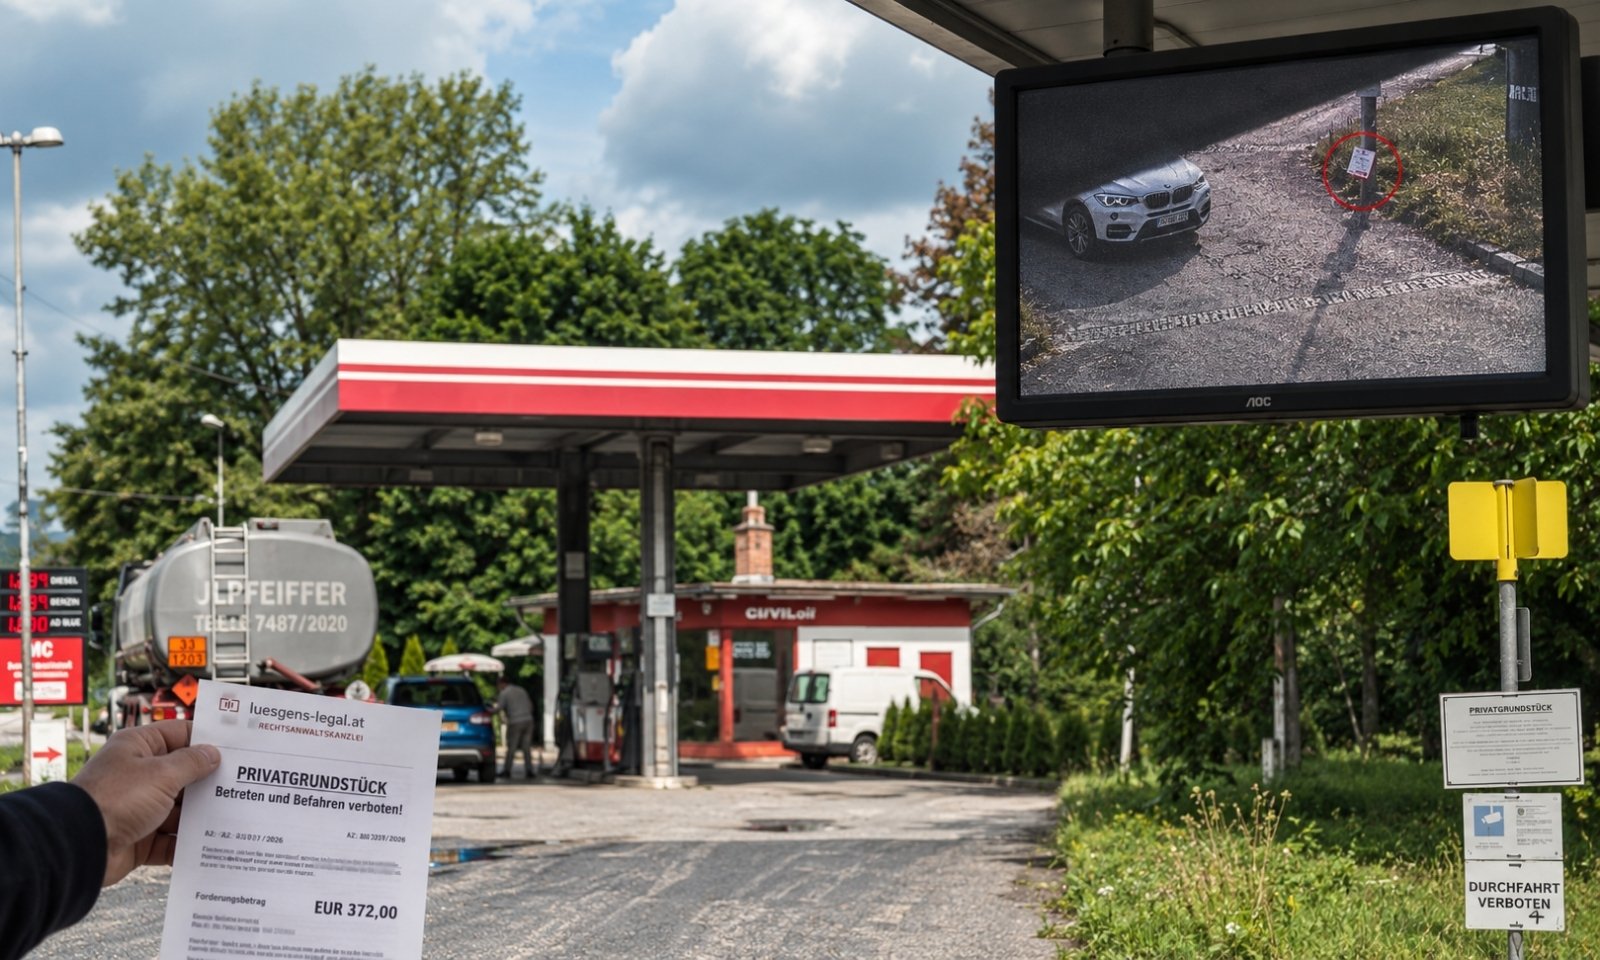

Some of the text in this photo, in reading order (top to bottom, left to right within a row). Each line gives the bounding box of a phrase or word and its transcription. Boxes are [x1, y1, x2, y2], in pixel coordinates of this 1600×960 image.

[1246, 396, 1272, 408] AOC
[254, 614, 348, 632] 7487/2020
[179, 639, 196, 650] 33
[173, 652, 203, 665] 1203
[249, 701, 365, 729] luesgens-legal.at
[1469, 702, 1553, 715] PRIVATGRUNDSTÜCK
[258, 722, 364, 742] RECHTSANWALTSKANZLEI
[236, 765, 388, 795] PRIVATGRUNDSTÜCK
[215, 785, 403, 816] Betreten und Befahren verboten!
[1468, 881, 1561, 894] DURCHFAHRT
[195, 891, 266, 907] Forderungsbetrag
[1477, 896, 1551, 910] VERBOTEN
[314, 900, 398, 920] EUR 372,00
